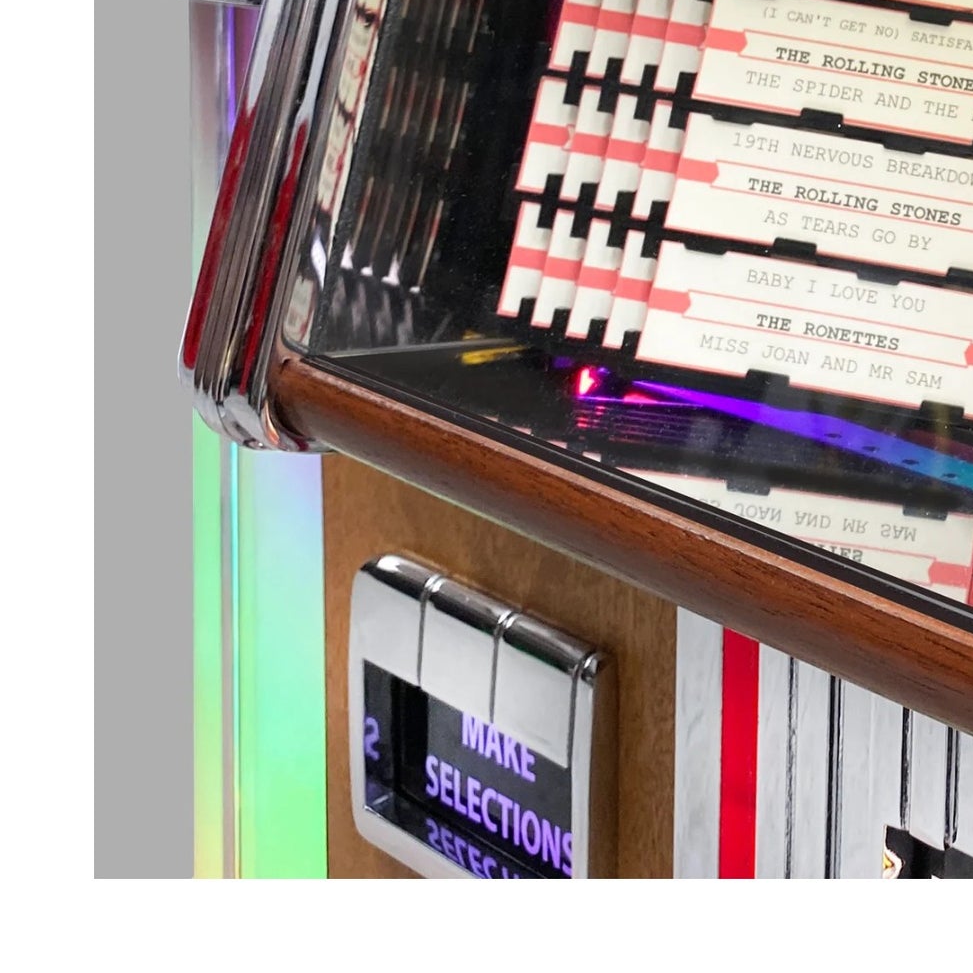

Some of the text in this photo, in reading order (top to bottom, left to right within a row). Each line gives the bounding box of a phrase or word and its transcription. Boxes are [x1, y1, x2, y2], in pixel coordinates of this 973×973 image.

[762, 5, 777, 20] (I
[785, 10, 831, 28] CAN'T
[838, 18, 868, 35] GET
[874, 23, 901, 41] NO)
[775, 45, 811, 66] THE
[822, 52, 906, 81] ROLLING
[746, 70, 782, 88] THE
[792, 78, 864, 103] SPIDER
[874, 92, 912, 111] AND
[923, 99, 959, 120] THE
[733, 133, 780, 154] 19TH
[791, 142, 875, 171] NERVOUS
[747, 177, 962, 227] THE ROLLING STONES
[764, 210, 933, 252] AS TEARS GO BY
[746, 268, 926, 314] BABY I LOVE YOU
[756, 313, 900, 352] THE RONETTES
[699, 333, 943, 391] MISS JOAN AND MR SAM
[461, 711, 536, 782] MAKE
